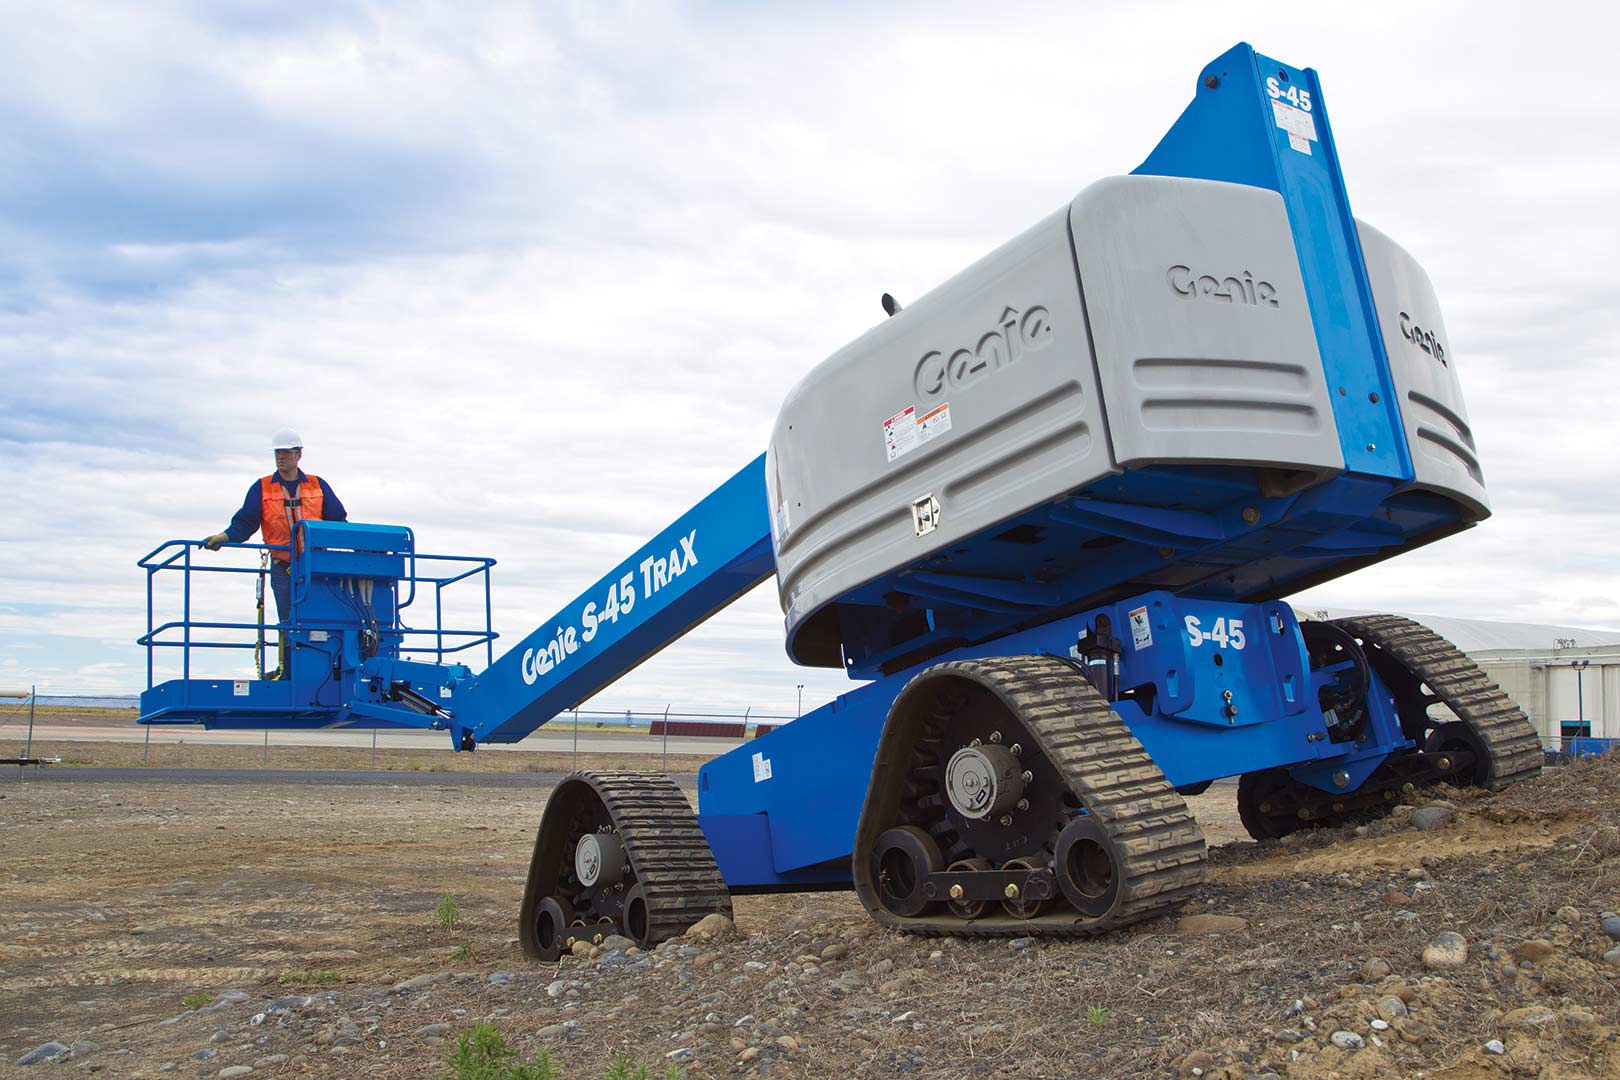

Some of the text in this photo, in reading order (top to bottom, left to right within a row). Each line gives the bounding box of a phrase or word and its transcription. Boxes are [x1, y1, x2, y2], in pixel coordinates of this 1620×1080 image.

[1266, 76, 1313, 112] S-45
[1166, 264, 1280, 309] Genie
[913, 305, 1054, 401] Genie
[1399, 311, 1448, 369] Genie
[521, 529, 699, 686] Genie S-45 TRAX
[1184, 615, 1246, 650] S-45
